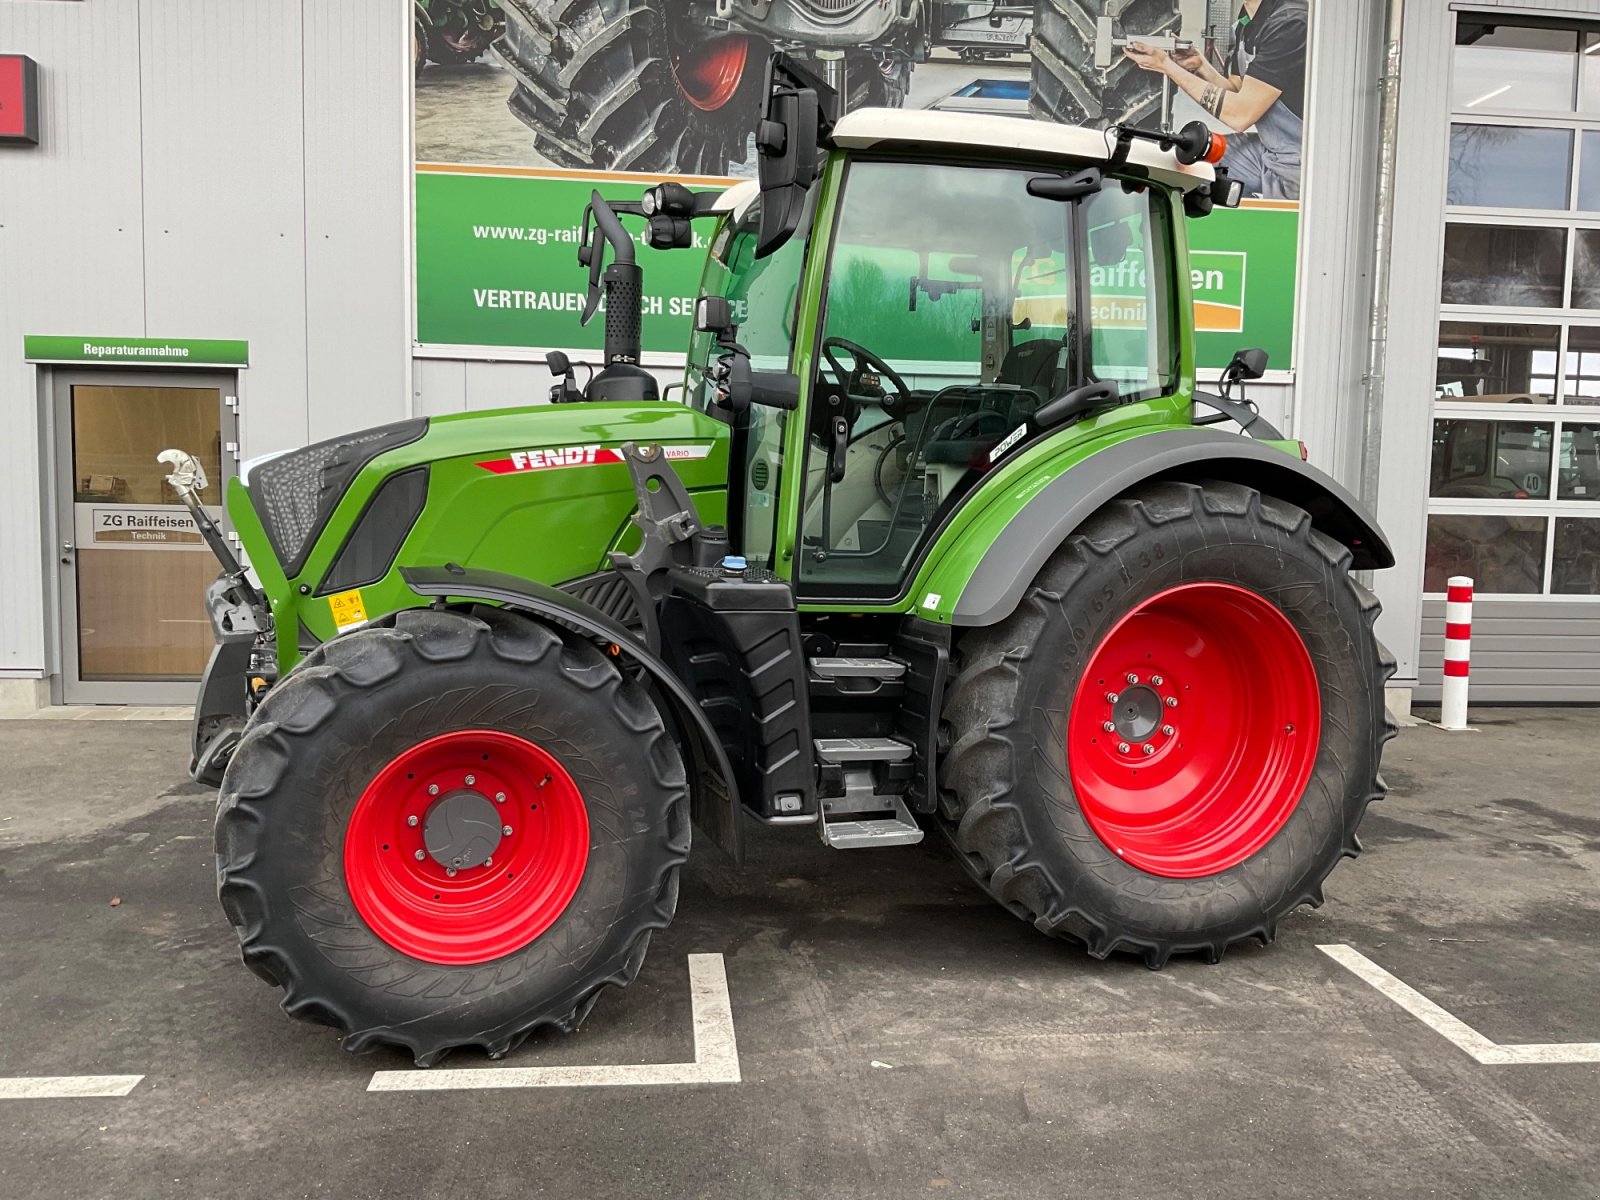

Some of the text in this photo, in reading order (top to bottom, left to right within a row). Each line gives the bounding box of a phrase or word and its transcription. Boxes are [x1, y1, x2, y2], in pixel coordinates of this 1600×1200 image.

[473, 289, 589, 312] VERTRAUEN
[598, 294, 662, 315] DCH
[1091, 302, 1146, 321] echni
[83, 343, 189, 357] Reparaturannahme
[994, 428, 1023, 457] POWER
[510, 444, 600, 470] FENDT
[1526, 475, 1539, 490] 40
[103, 514, 193, 527] ZG Raiffeisen
[131, 531, 166, 540] Technik
[1139, 542, 1165, 569] 38
